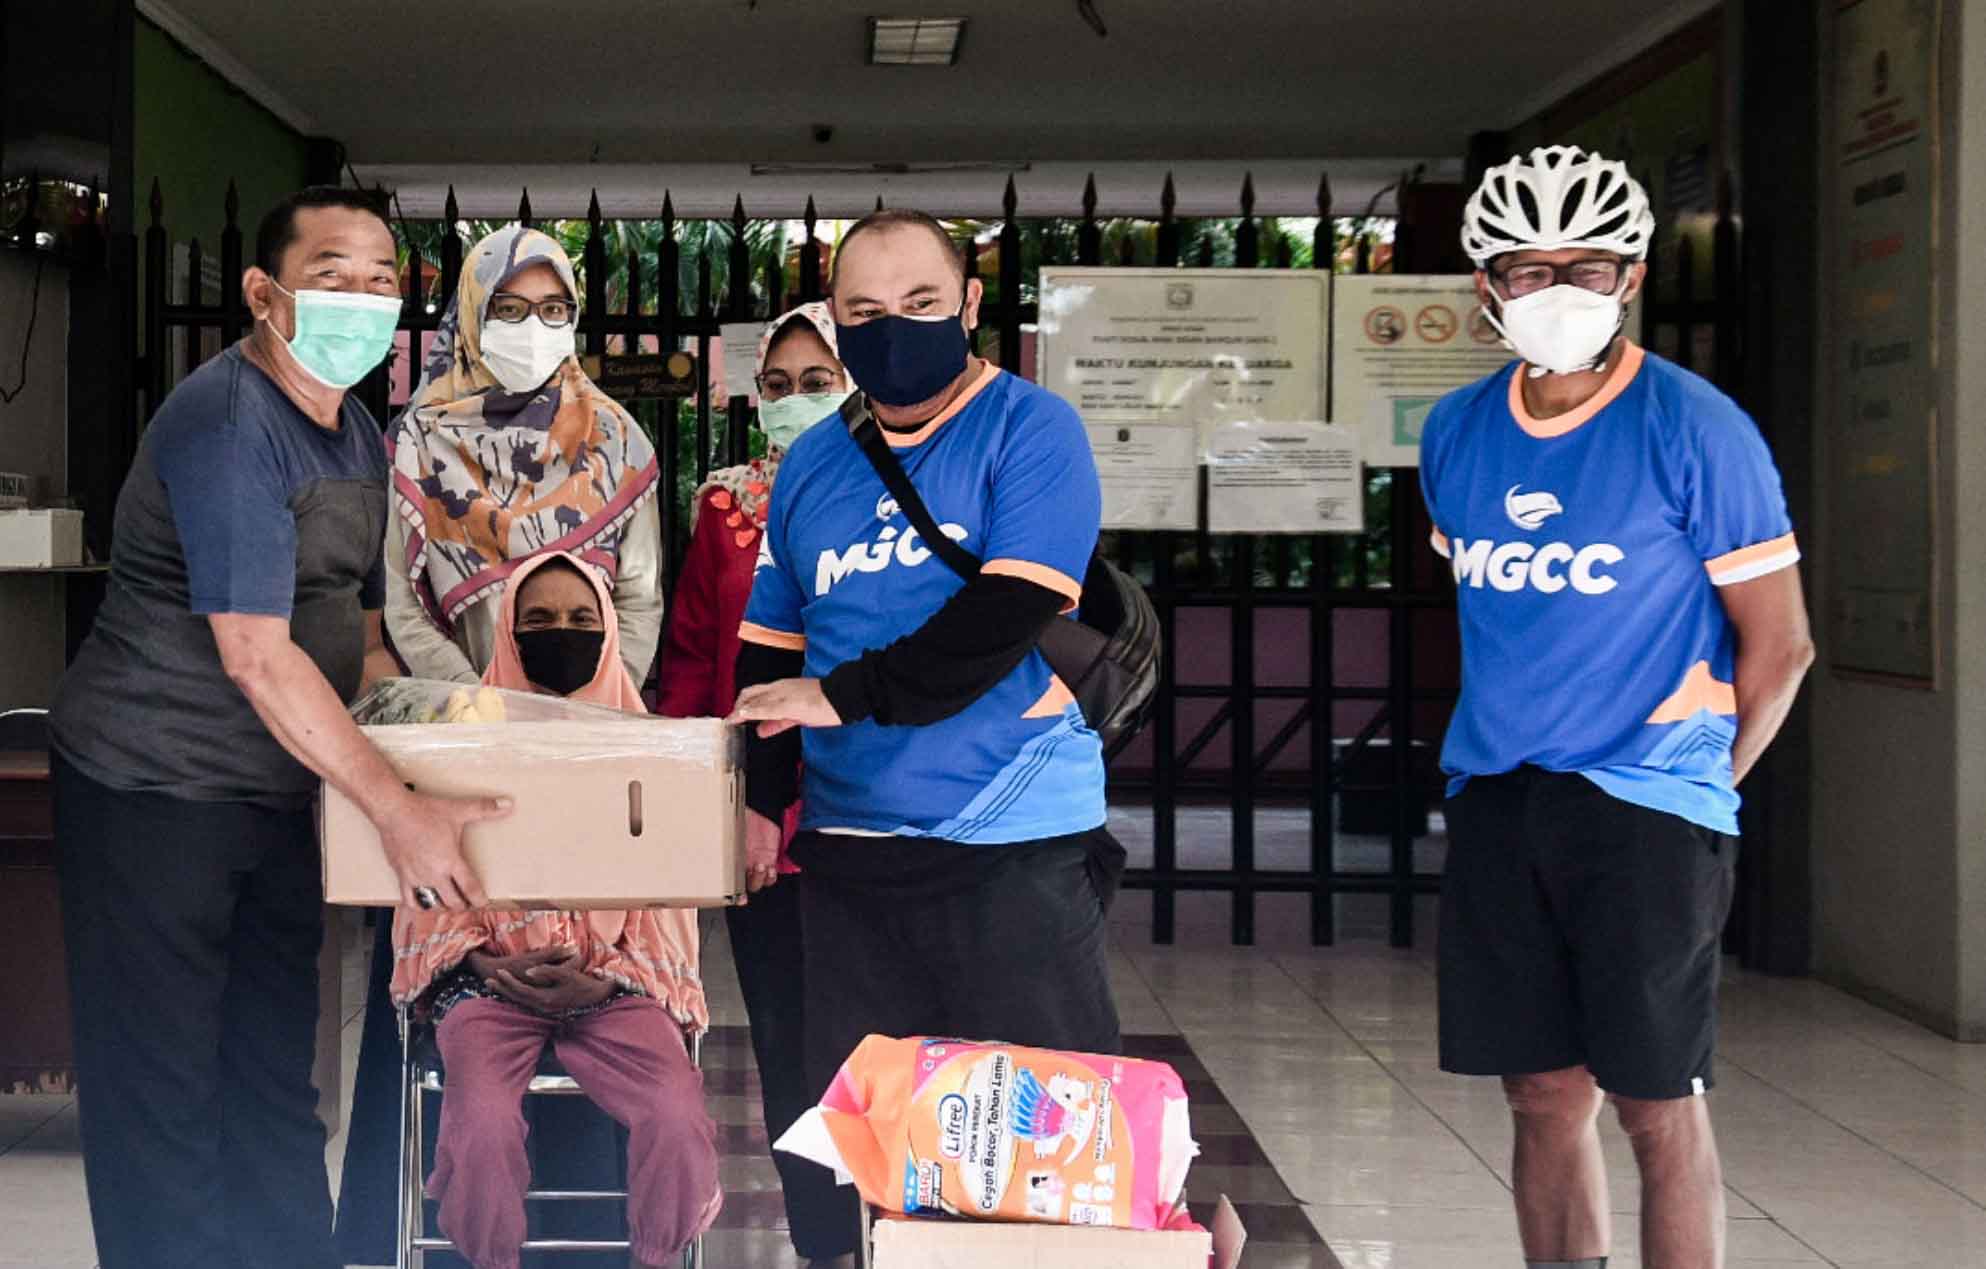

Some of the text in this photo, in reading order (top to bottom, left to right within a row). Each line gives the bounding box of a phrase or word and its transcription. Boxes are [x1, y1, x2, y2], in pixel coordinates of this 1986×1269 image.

[1075, 359, 1124, 369] WAKTU
[1127, 358, 1213, 369] KUNJUNGAN
[1453, 537, 1625, 595] MGCC
[945, 1103, 963, 1153] Lifree
